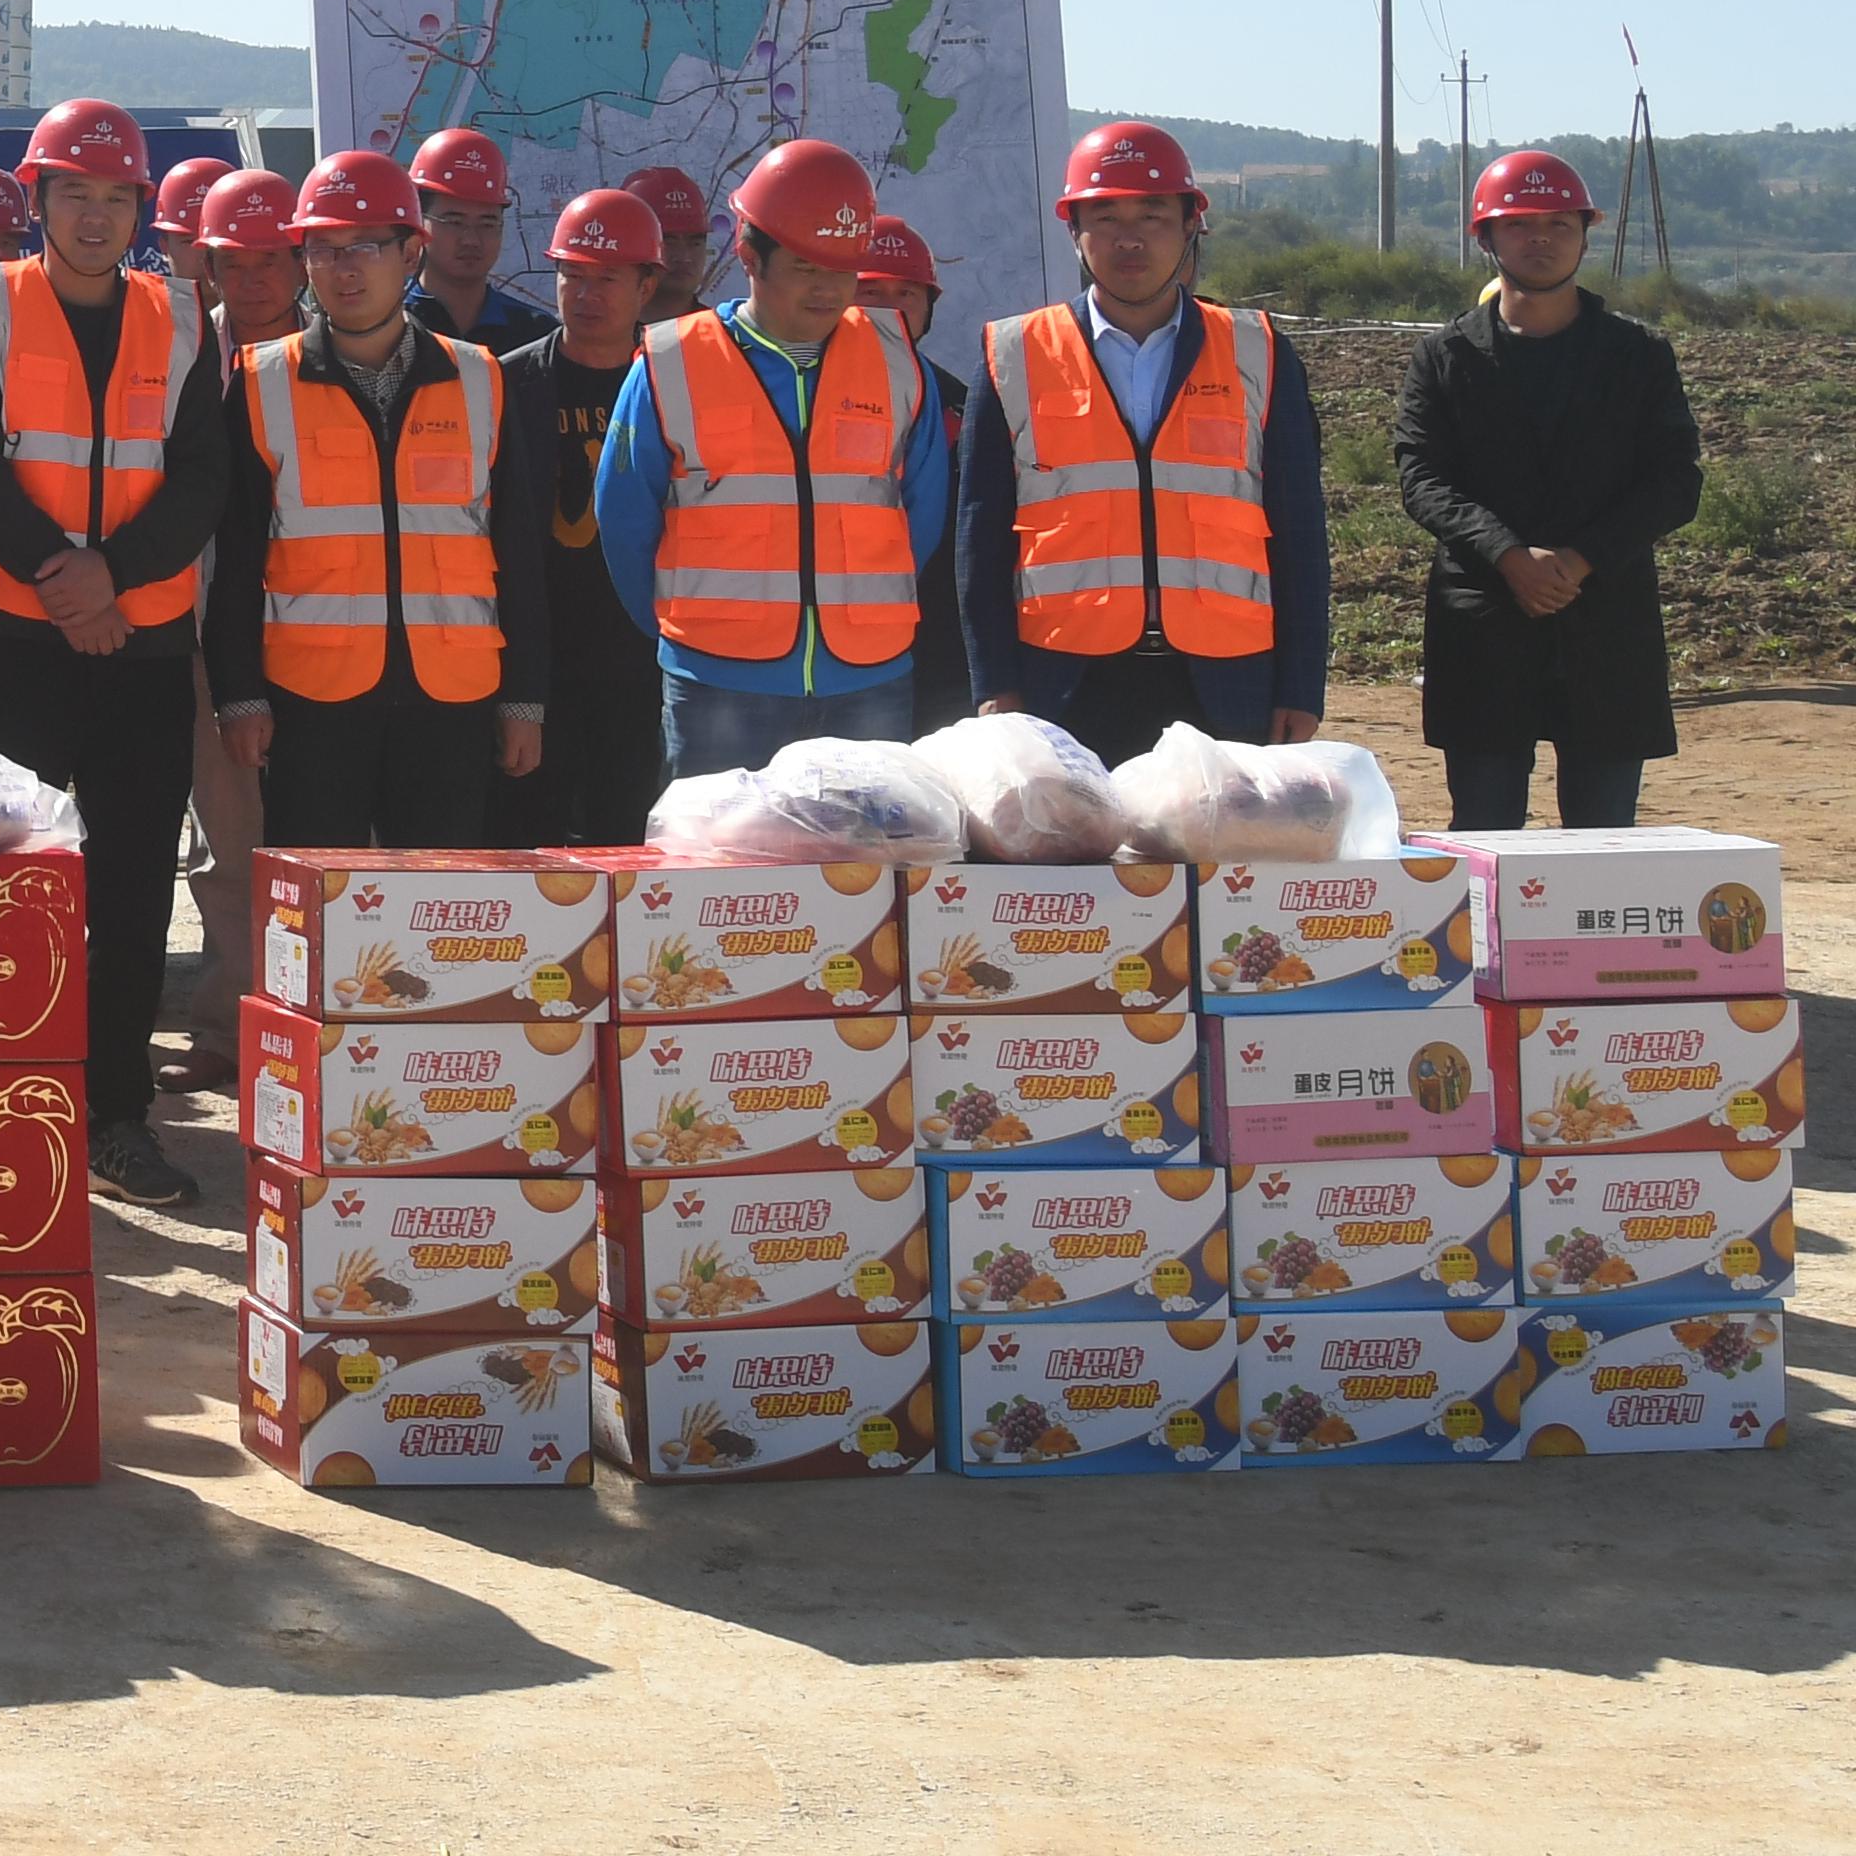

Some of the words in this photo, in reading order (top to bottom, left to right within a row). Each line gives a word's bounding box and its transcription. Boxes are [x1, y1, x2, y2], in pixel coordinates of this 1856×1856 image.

[540, 173, 577, 194] 城区
[1576, 906, 1684, 934] 蛋皮月饼
[1294, 1067, 1395, 1097] 蛋皮月饼
